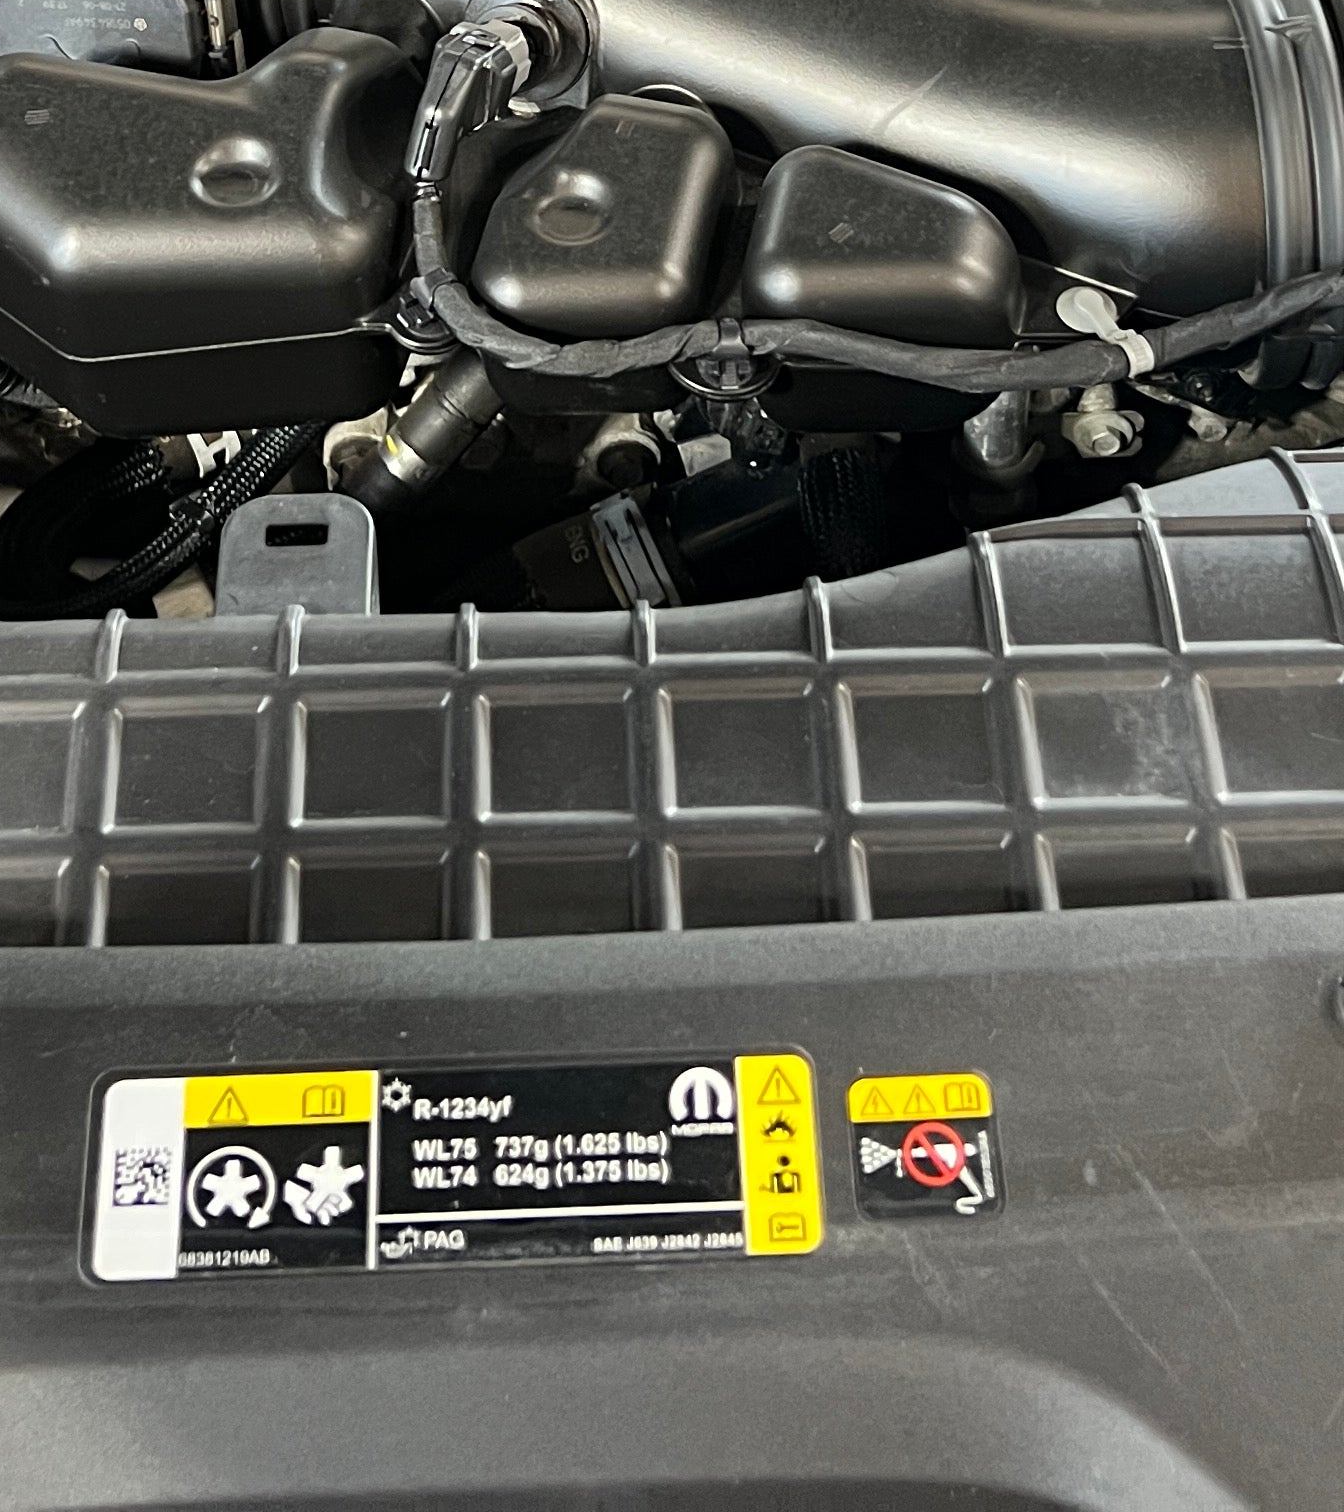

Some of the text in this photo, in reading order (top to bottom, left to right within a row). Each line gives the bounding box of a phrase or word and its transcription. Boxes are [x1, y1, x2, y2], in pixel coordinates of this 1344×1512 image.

[413, 1095, 513, 1122] R-1234yf
[413, 1130, 670, 1162] WL75 737g (1.625 lbs)
[413, 1158, 672, 1189] WL74 624g (1.375 lbs)
[423, 1230, 466, 1250] PAG
[593, 1236, 623, 1252] SAE
